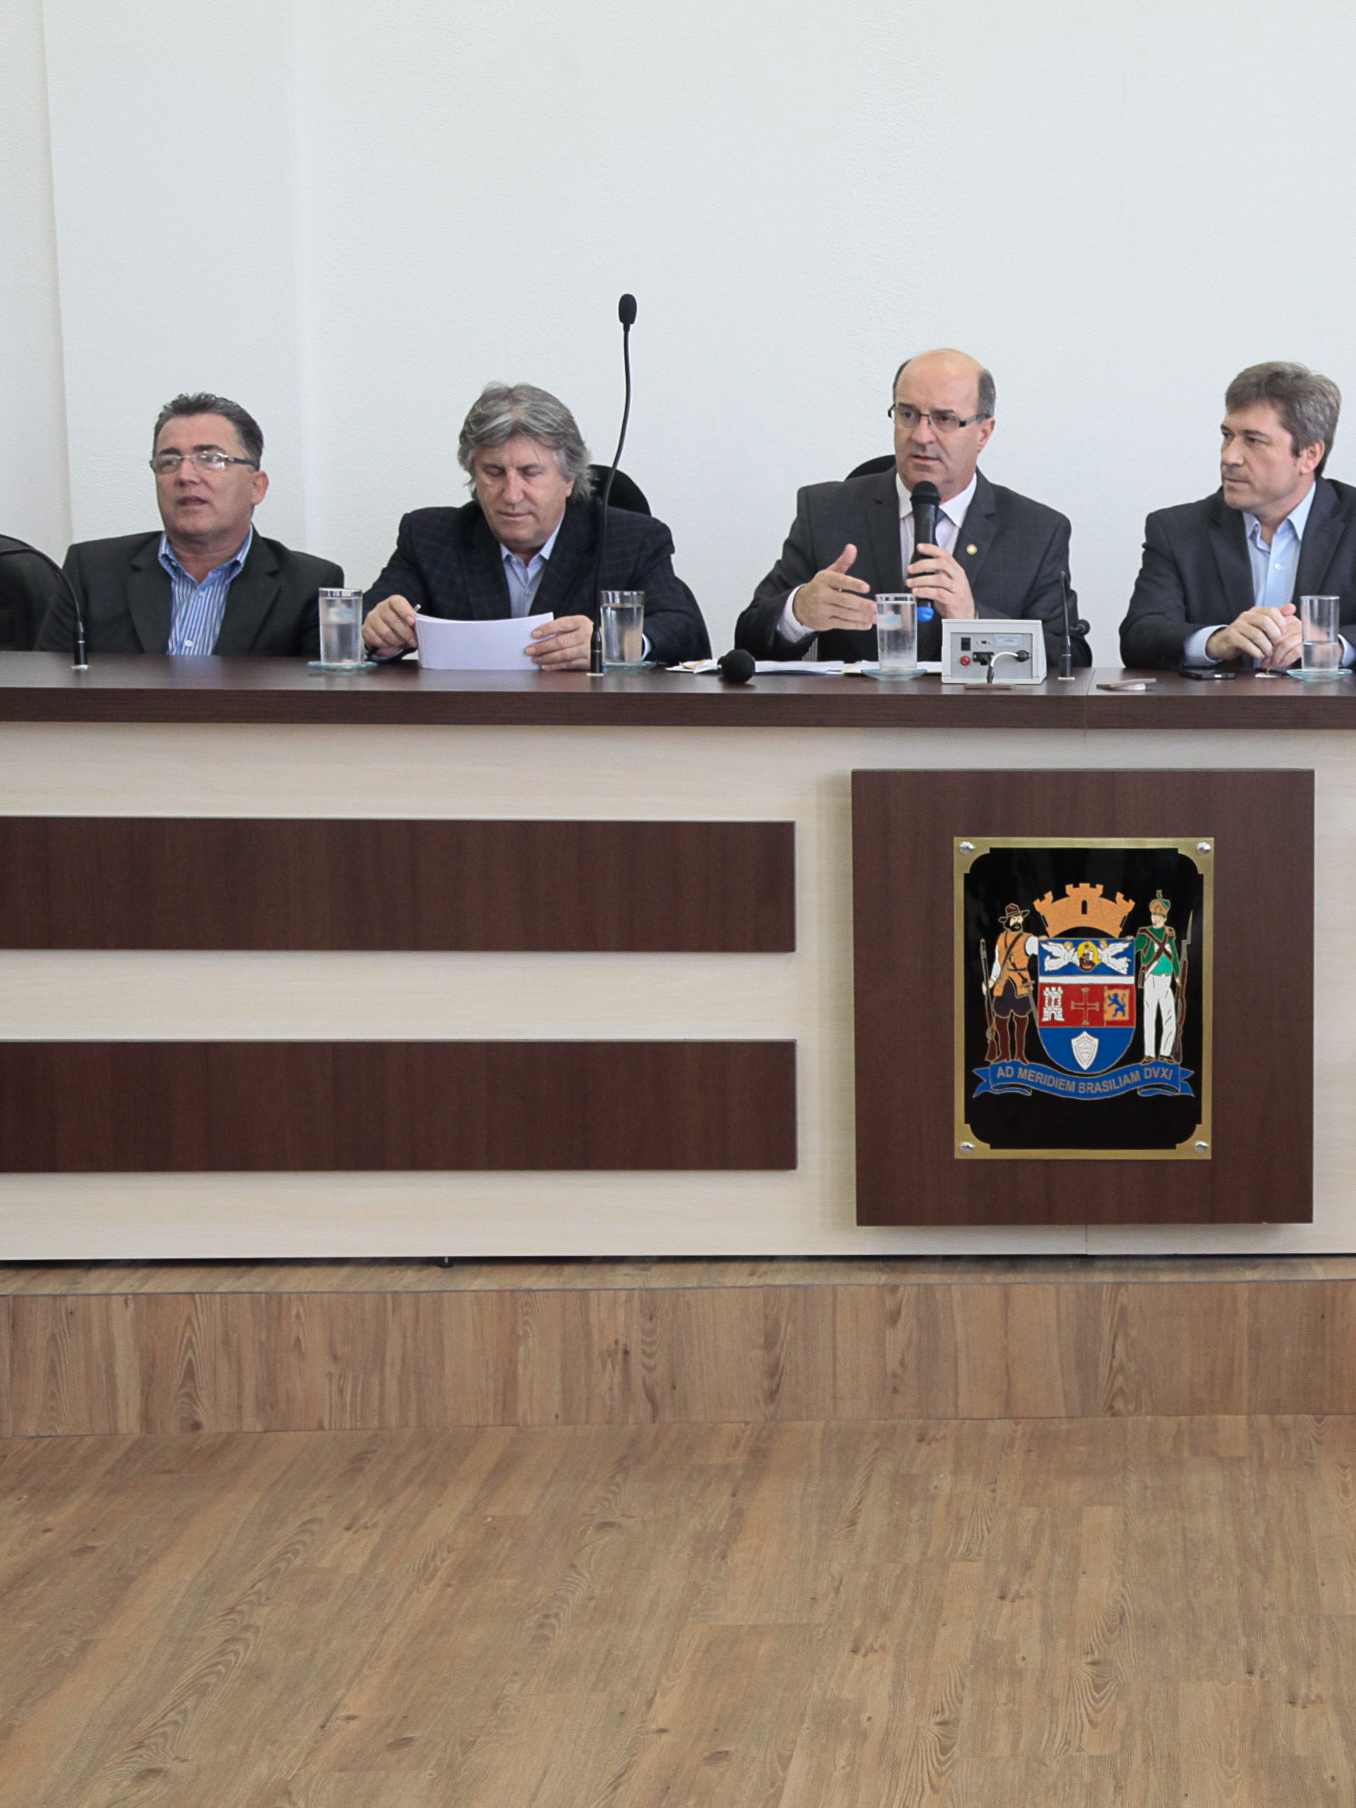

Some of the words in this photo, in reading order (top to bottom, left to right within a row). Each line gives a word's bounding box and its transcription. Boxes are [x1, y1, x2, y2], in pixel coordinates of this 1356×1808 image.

[996, 1066, 1015, 1079] AD
[1017, 1068, 1076, 1092] MERIDIEM
[1078, 1068, 1141, 1094] BRASILIAM
[1144, 1067, 1173, 1081] DVXI
